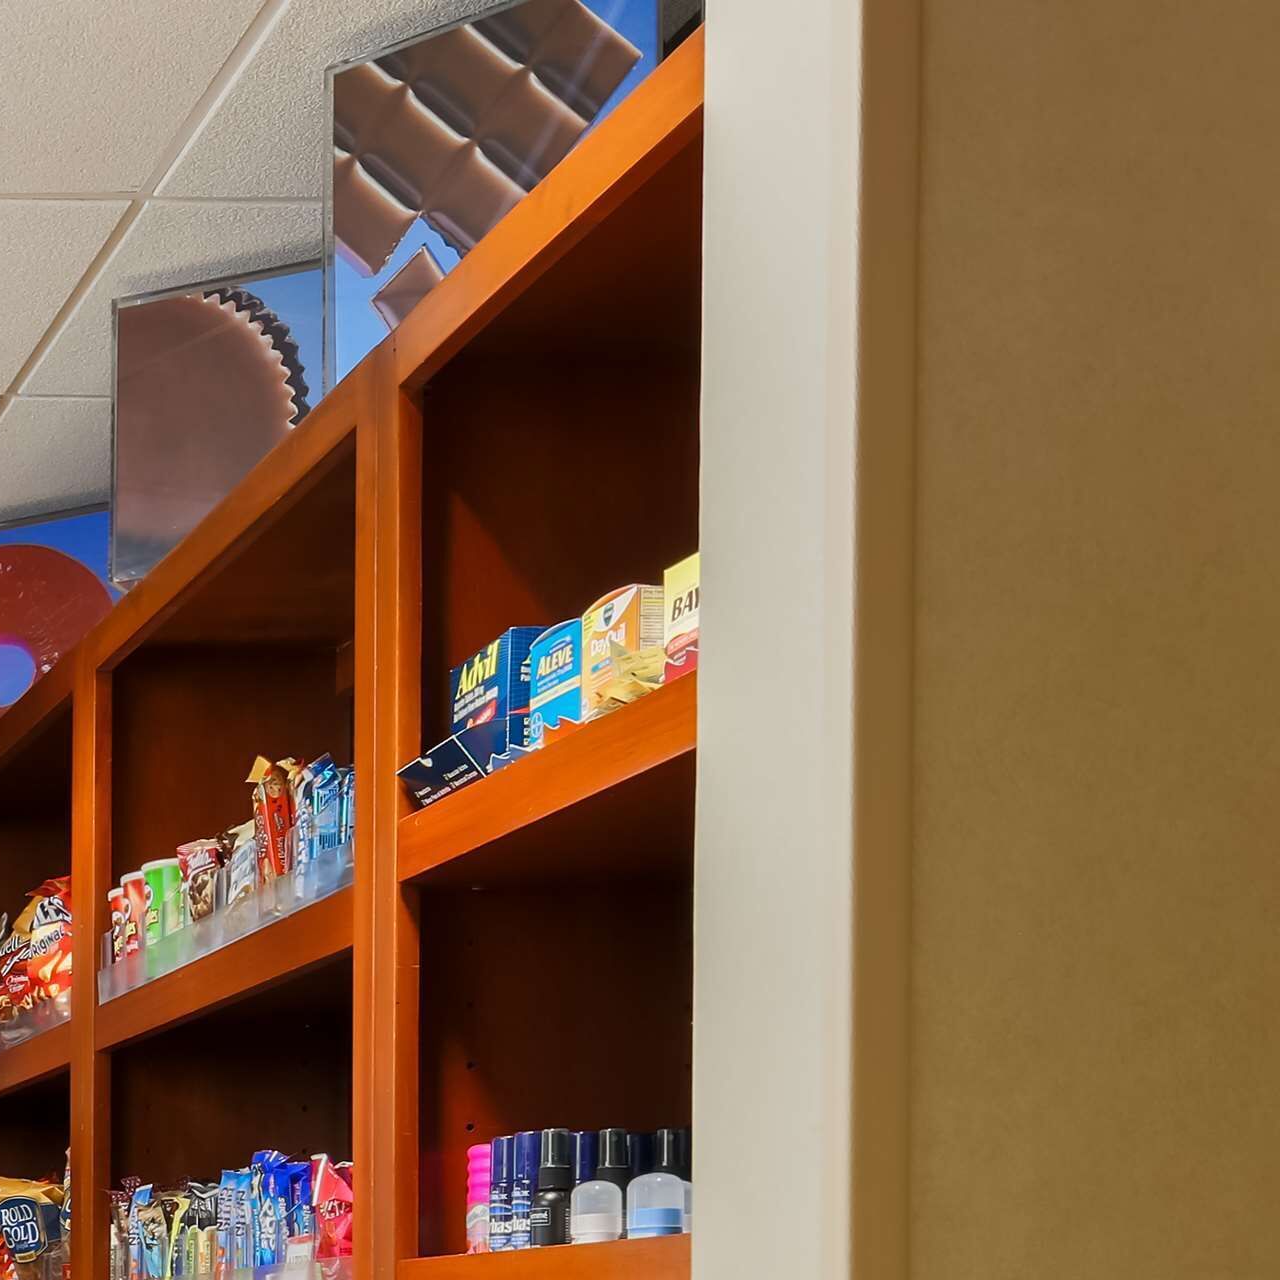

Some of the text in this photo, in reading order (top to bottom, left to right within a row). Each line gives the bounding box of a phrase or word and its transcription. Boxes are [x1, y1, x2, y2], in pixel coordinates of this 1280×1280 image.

[455, 638, 500, 700] Advil
[536, 645, 574, 680] ALEVE
[1, 1204, 36, 1226] ROLD
[2, 1222, 40, 1249] GOLD
